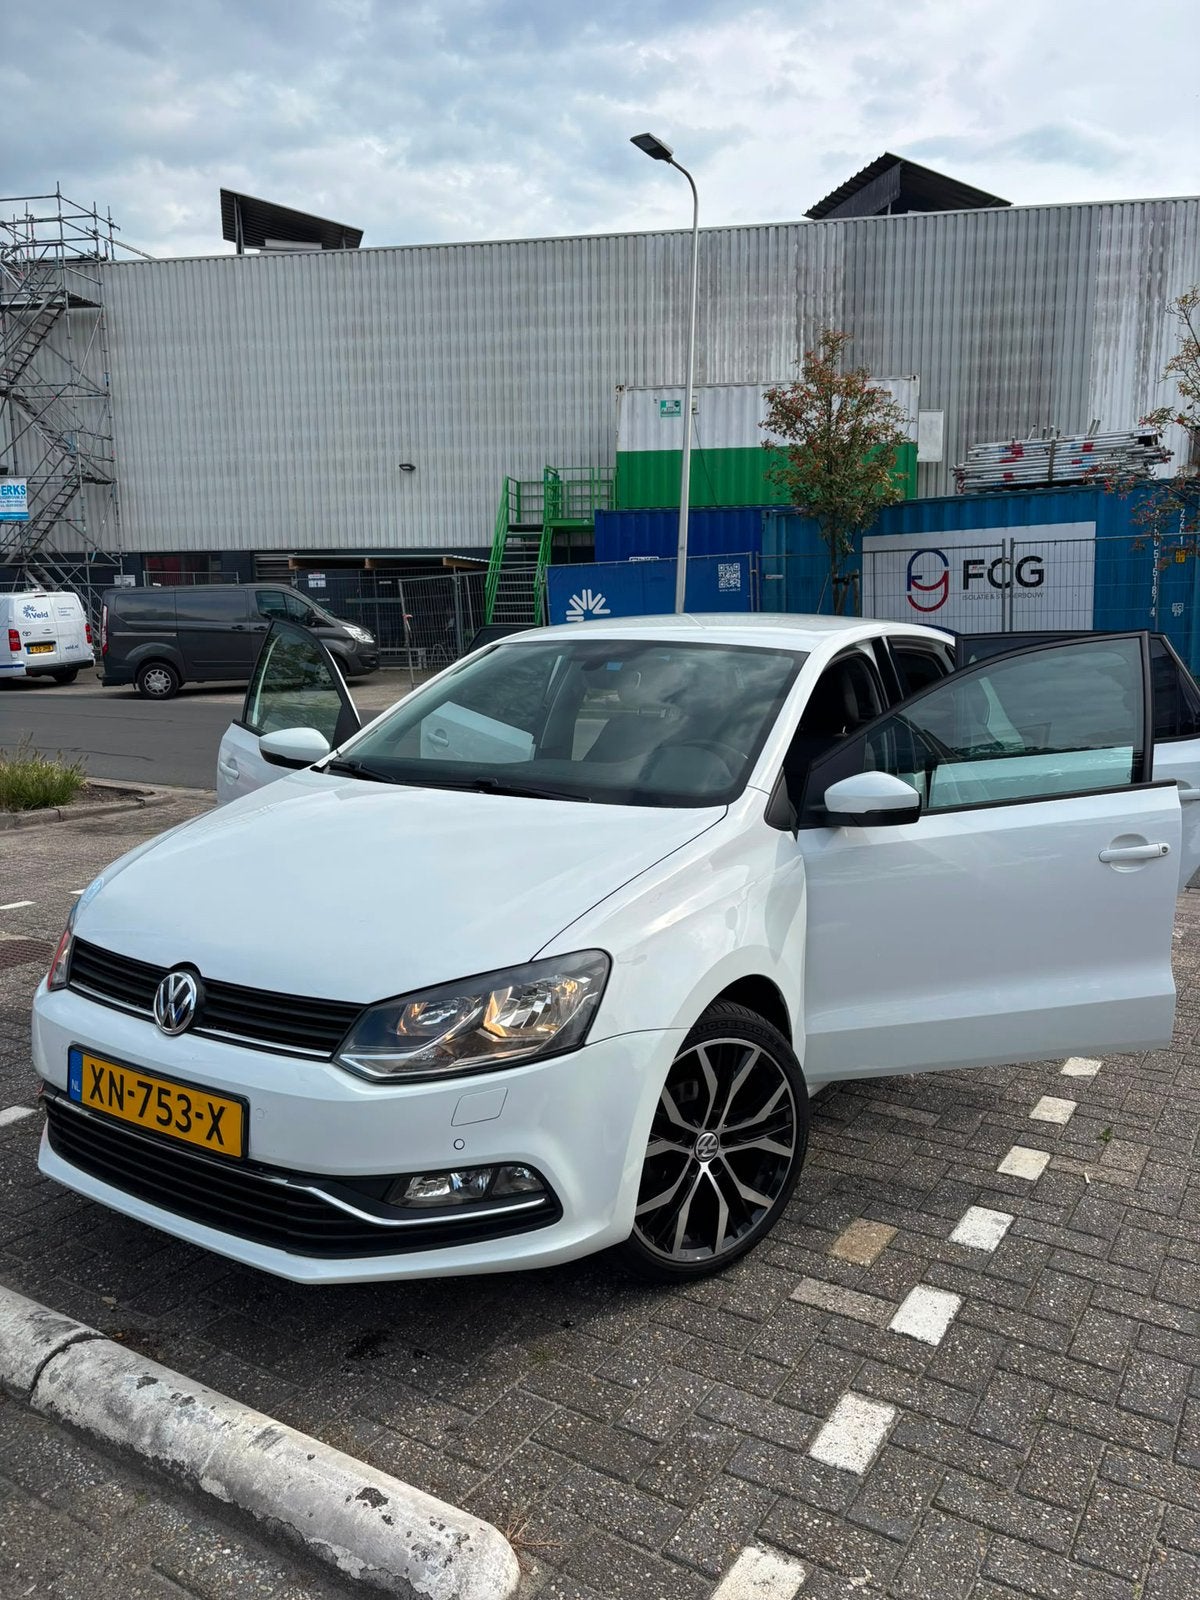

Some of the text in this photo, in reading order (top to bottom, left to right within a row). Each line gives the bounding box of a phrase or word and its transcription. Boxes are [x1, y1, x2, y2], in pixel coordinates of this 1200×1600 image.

[1, 485, 26, 496] ERKS
[962, 555, 1045, 590] FCG
[996, 592, 1044, 600] SEIERBOUW
[31, 611, 49, 619] Veld
[71, 1078, 81, 1093] NL
[89, 1063, 226, 1146] XN-753-X
